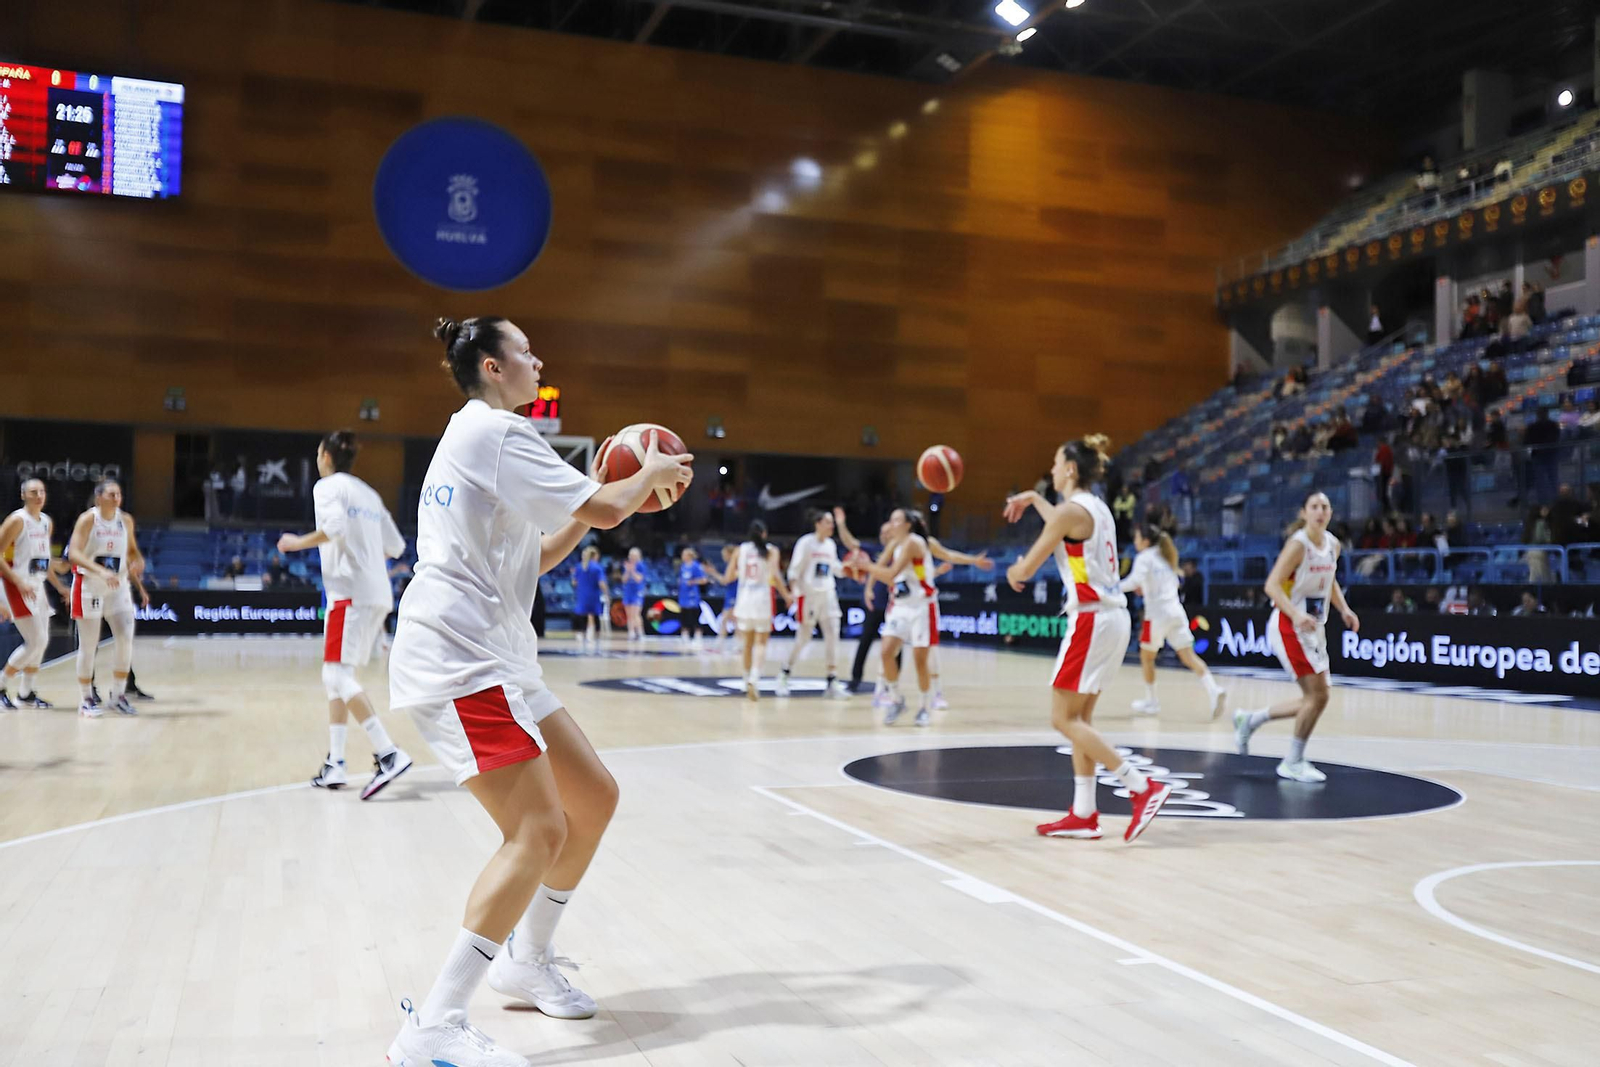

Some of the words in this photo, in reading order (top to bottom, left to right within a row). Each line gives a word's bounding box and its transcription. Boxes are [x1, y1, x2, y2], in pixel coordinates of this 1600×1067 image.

[51, 70, 61, 86] 0
[89, 74, 99, 91] 0
[531, 398, 558, 419] 21
[17, 458, 120, 482] endesa
[194, 605, 239, 622] Región
[241, 605, 294, 623] Europea
[295, 606, 316, 621] del
[977, 610, 998, 635] del
[1342, 630, 1427, 668] Región
[1431, 634, 1553, 679] Europea
[1559, 640, 1600, 676] de
